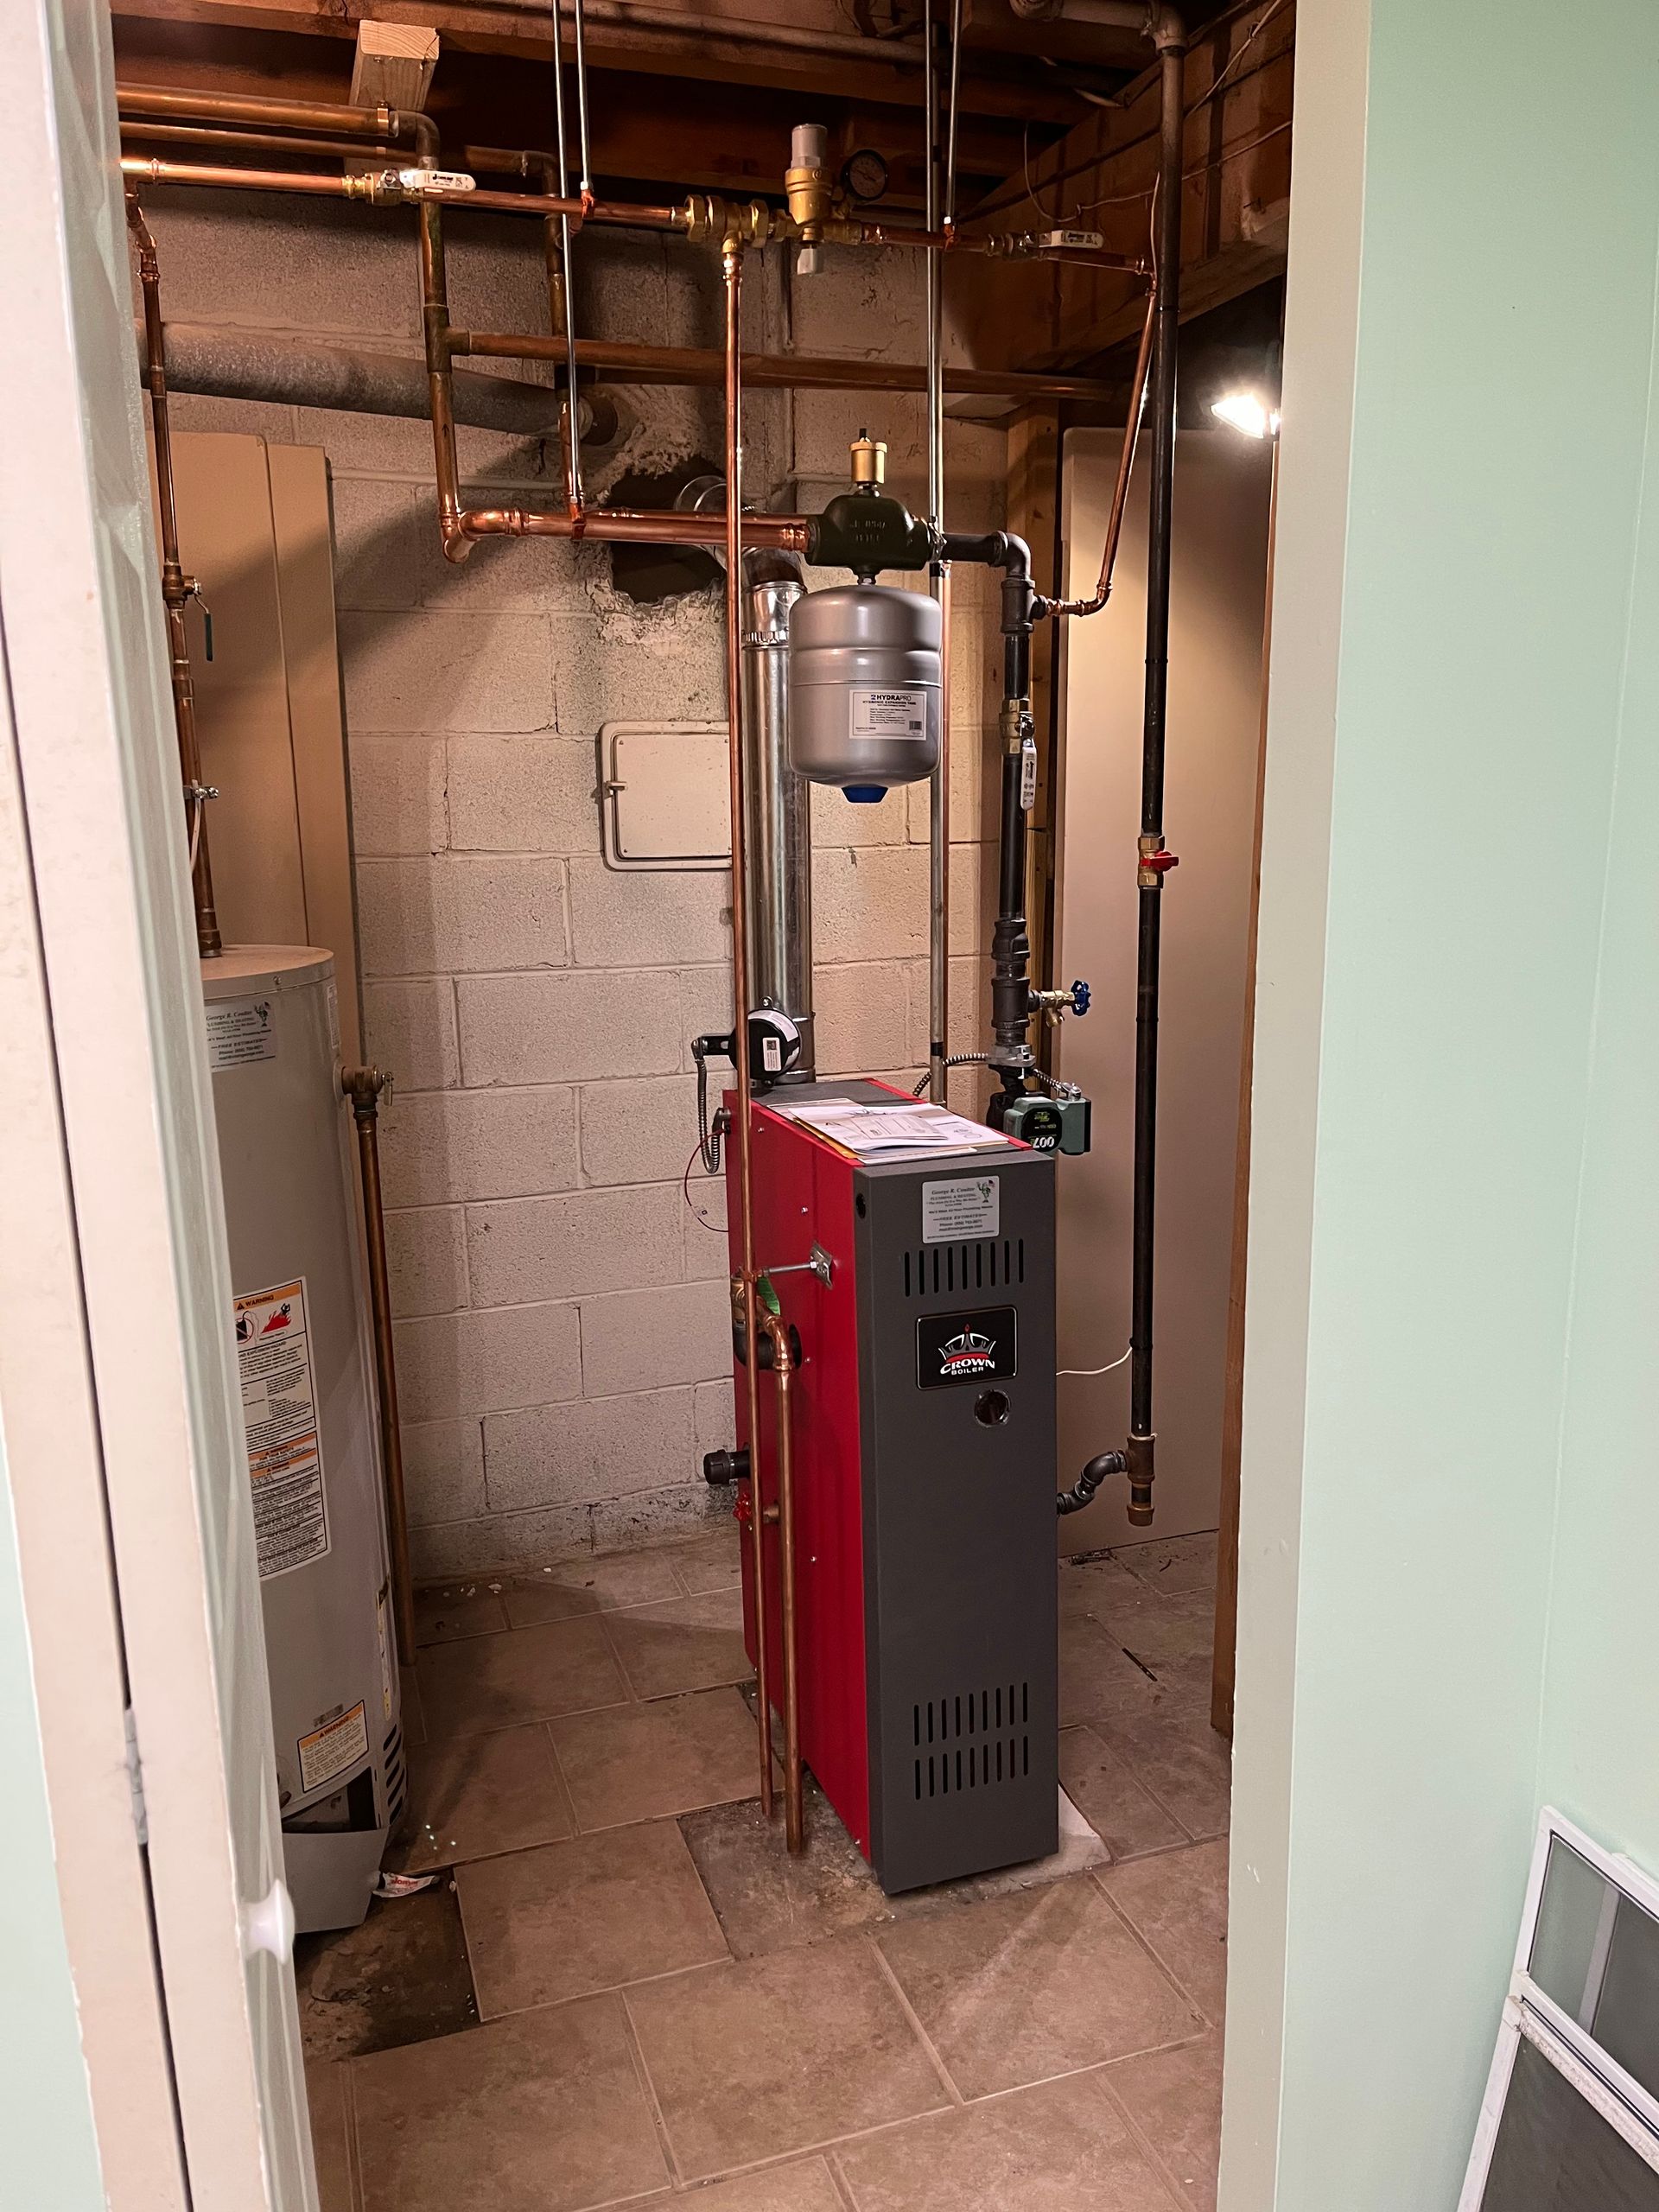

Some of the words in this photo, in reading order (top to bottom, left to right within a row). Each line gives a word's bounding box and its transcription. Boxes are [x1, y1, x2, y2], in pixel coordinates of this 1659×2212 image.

[1033, 1135, 1055, 1149] 007
[245, 1294, 275, 1307] WARNING
[939, 1357, 996, 1376] CROWN
[950, 1366, 984, 1376] BOILER
